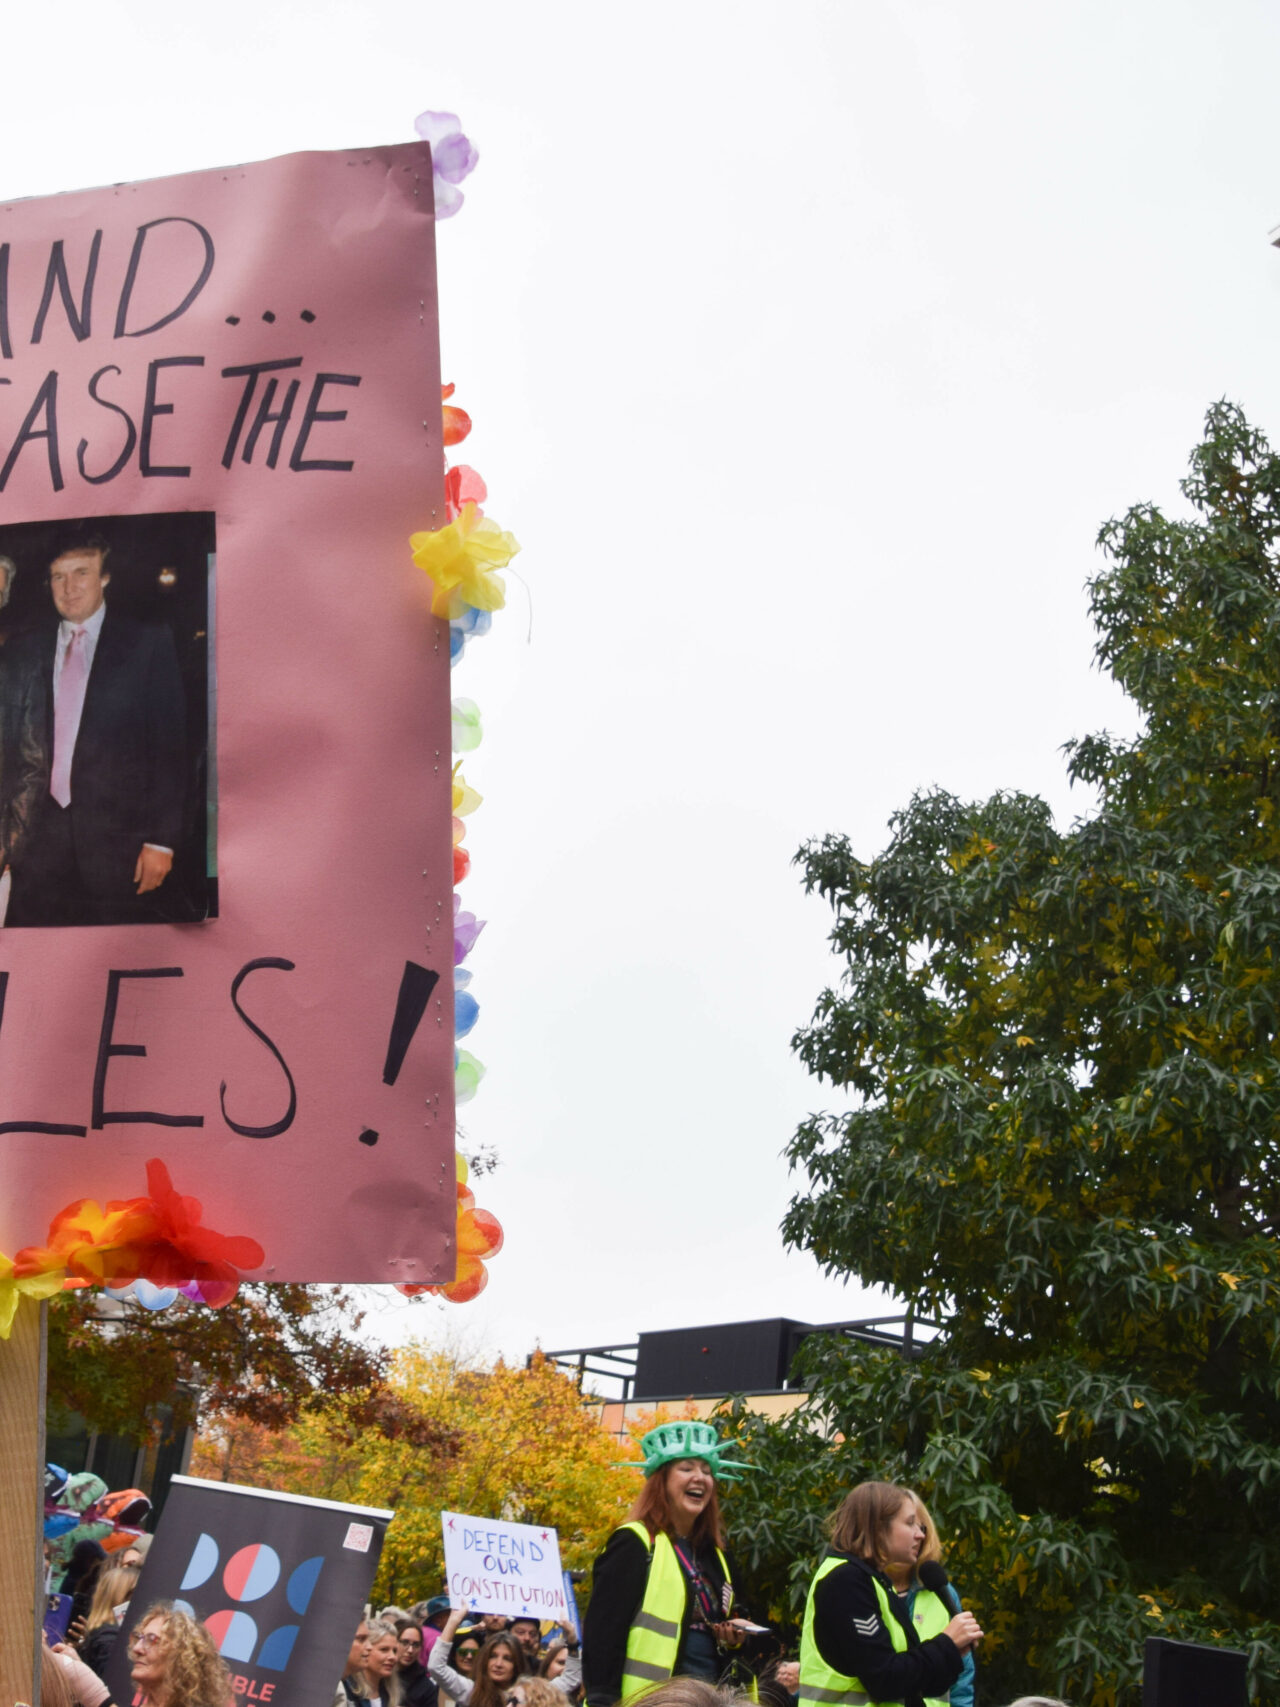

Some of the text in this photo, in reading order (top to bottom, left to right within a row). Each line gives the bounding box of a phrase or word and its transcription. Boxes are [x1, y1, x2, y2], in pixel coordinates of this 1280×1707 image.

[221, 355, 362, 472] THE
[463, 1528, 544, 1562] DEFEND
[483, 1554, 523, 1577] OUR
[451, 1573, 565, 1608] CONSTITUTION
